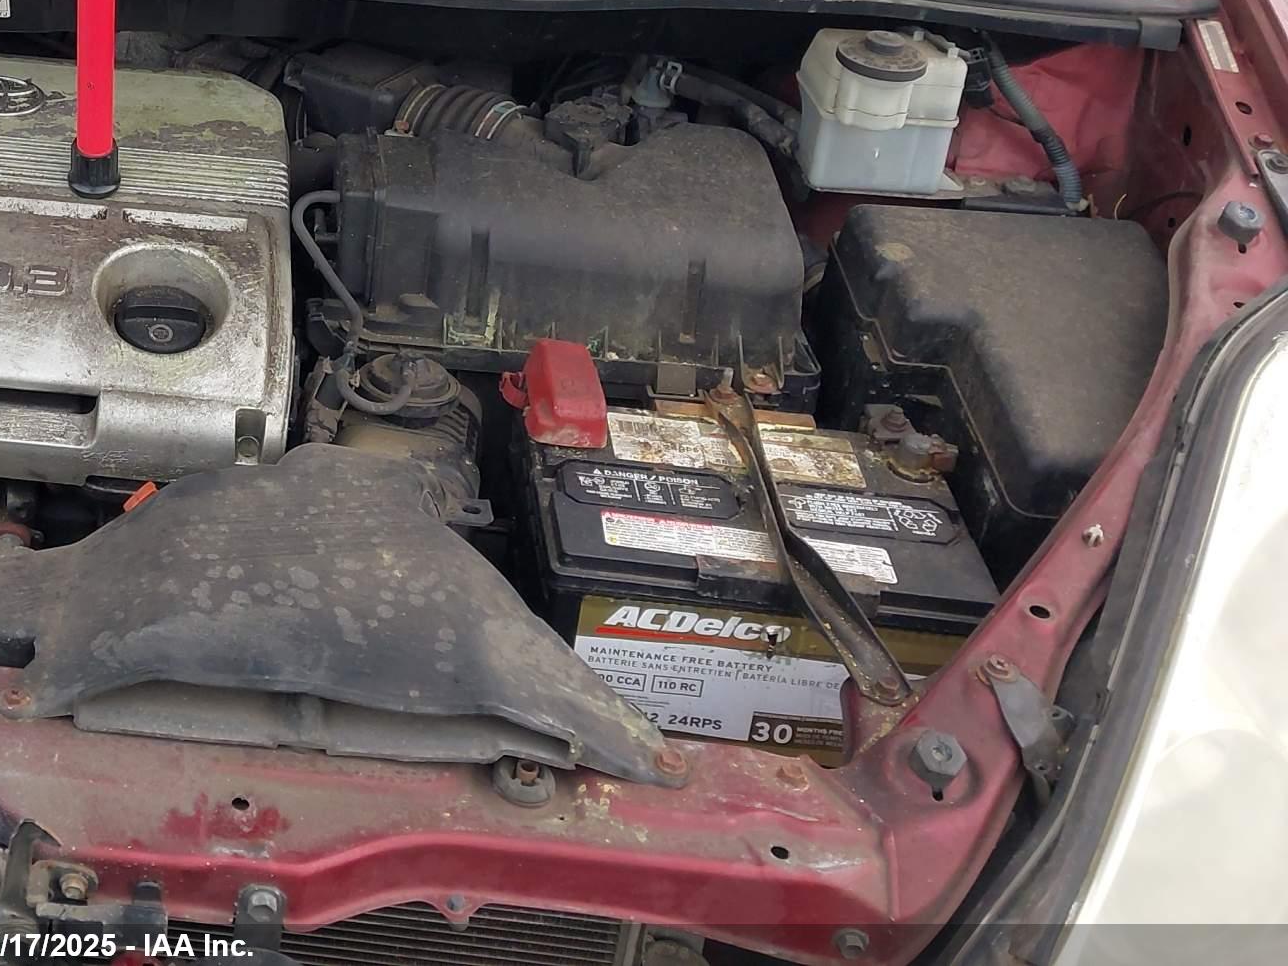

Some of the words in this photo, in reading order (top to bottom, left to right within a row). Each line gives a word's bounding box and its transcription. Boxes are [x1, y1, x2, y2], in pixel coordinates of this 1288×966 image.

[604, 469, 648, 481] DANGER
[657, 475, 699, 485] POISON
[603, 605, 792, 643] ACDelco
[587, 655, 641, 668] BATTERIE
[641, 661, 669, 671] SANS
[672, 664, 732, 679] ENTRETIEN
[590, 646, 677, 662] MAINTENANCE
[681, 655, 713, 667] FREE
[717, 660, 773, 673] BATTERY
[616, 675, 641, 687] CCA
[657, 680, 677, 690] 110
[679, 682, 697, 693] RC
[742, 670, 788, 685] BATERÍA
[825, 681, 841, 690] DE
[667, 714, 722, 731] 24RPS
[751, 721, 793, 745] 30
